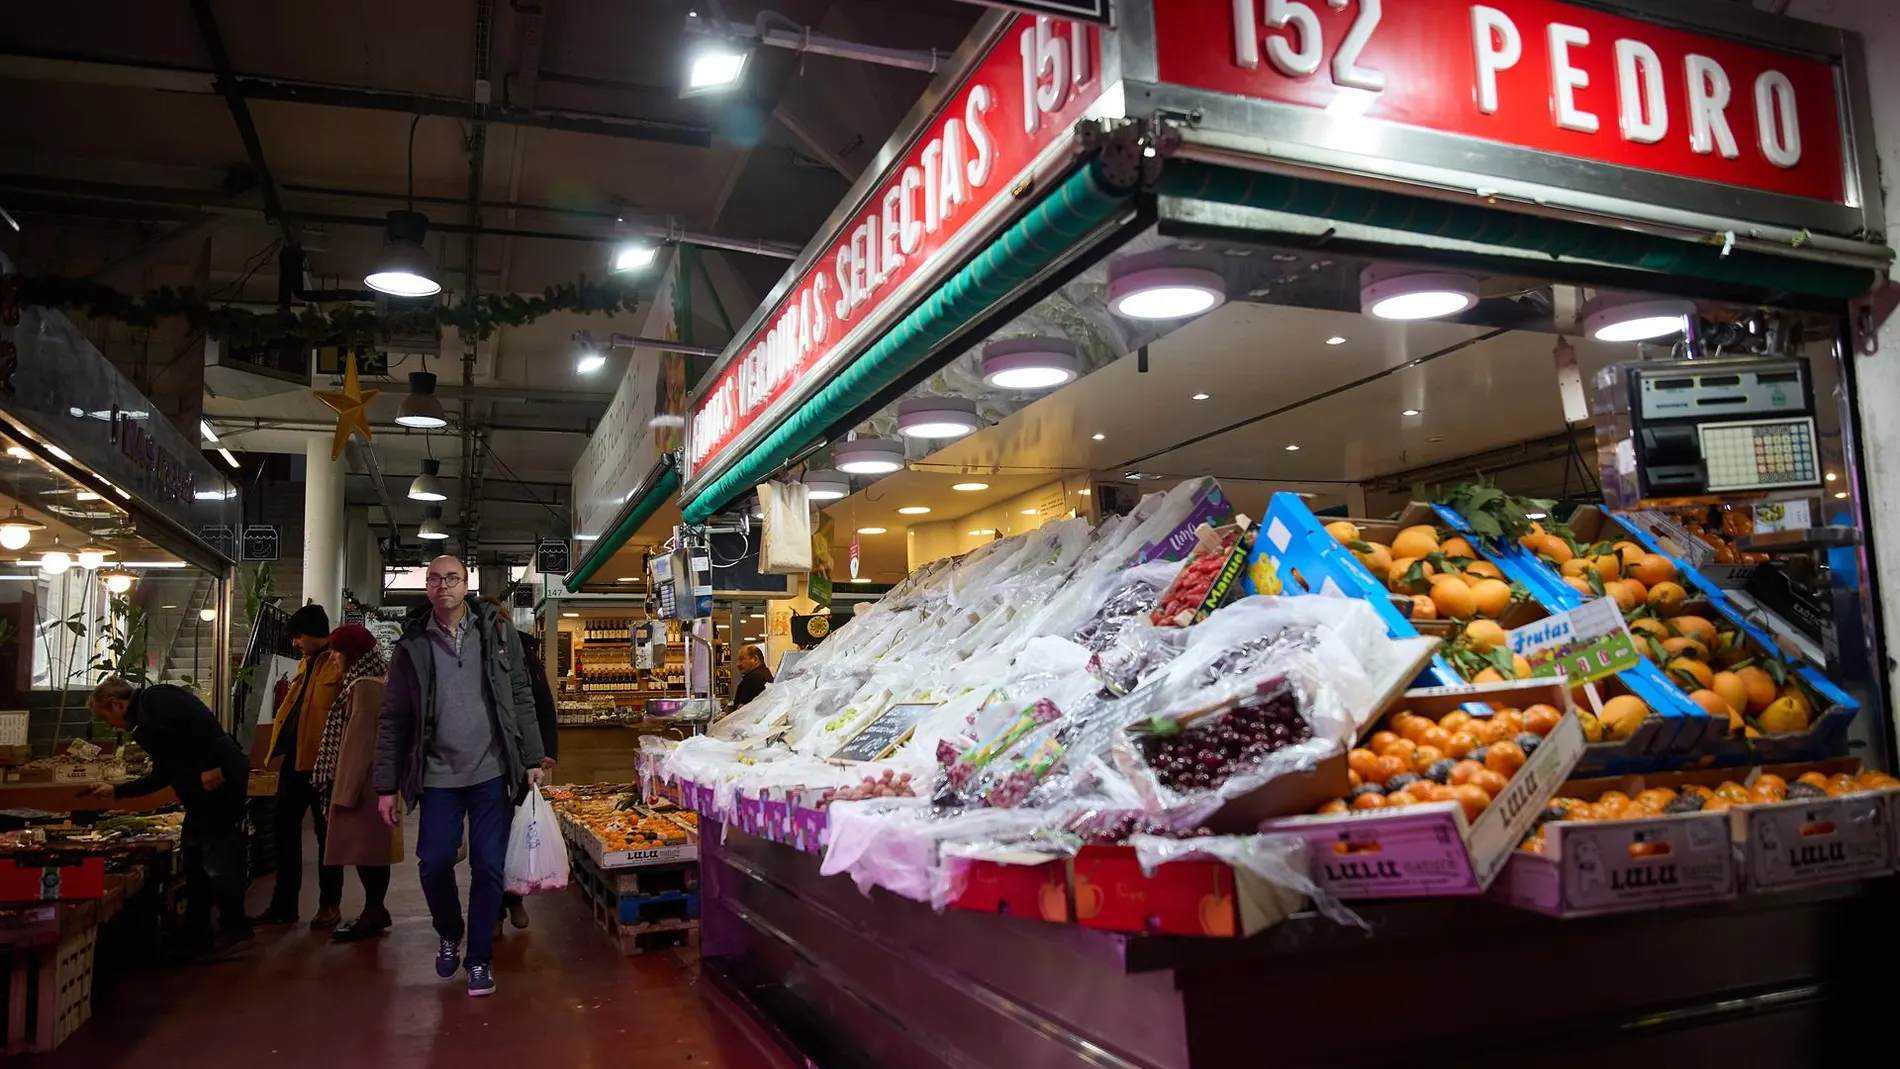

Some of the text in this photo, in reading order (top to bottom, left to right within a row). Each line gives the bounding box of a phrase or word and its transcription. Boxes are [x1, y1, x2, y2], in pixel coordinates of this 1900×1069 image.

[1232, 0, 1802, 169] 152 PEDRO
[836, 84, 994, 322] SELECTAS
[547, 588, 563, 597] 147
[1206, 546, 1247, 609] Manuel
[1511, 621, 1570, 655] Frutas
[1499, 769, 1538, 830] LULU
[627, 850, 659, 860] LULU
[1789, 842, 1845, 867] LULU
[1325, 860, 1402, 881] LULU
[1611, 864, 1679, 891] LULU
